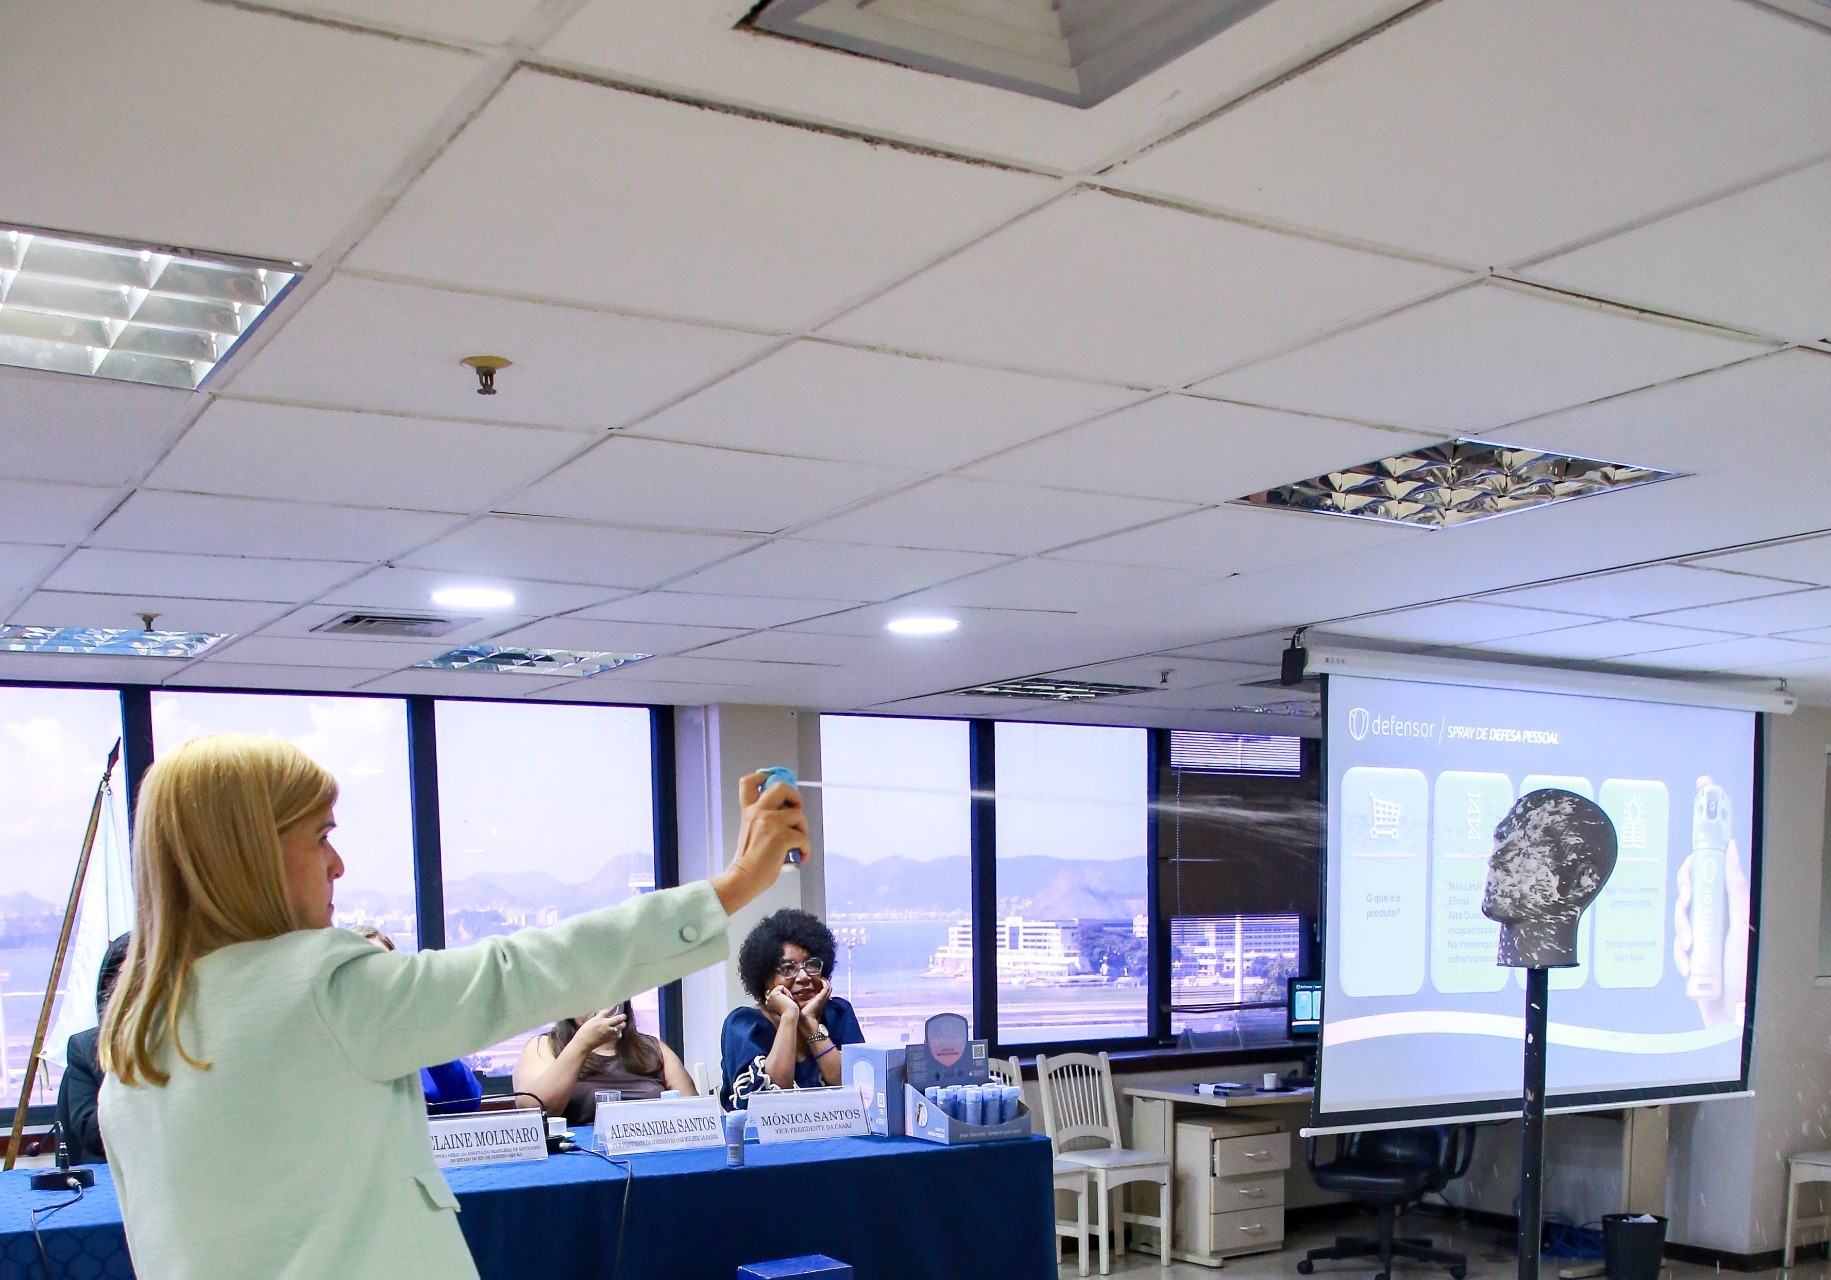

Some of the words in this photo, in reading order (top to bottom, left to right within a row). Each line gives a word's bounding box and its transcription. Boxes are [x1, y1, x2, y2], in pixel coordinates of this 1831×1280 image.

[1371, 714, 1434, 738] defensor
[1447, 725, 1475, 740] SPRAY
[1475, 727, 1488, 741] DE
[1489, 728, 1522, 743] DEFESA
[1522, 730, 1559, 745] PESSOAL
[1464, 882, 1482, 891] Letal
[1366, 893, 1373, 902] O
[1374, 895, 1388, 905] que
[1448, 896, 1470, 906] Eficaz
[1366, 907, 1401, 919] produto?
[1469, 953, 1498, 963] violênci
[814, 1109, 861, 1122] SANTOS
[611, 1120, 676, 1139] ALESSANDRA
[677, 1116, 717, 1133] SANTOS
[474, 1126, 539, 1147] MOLINARO
